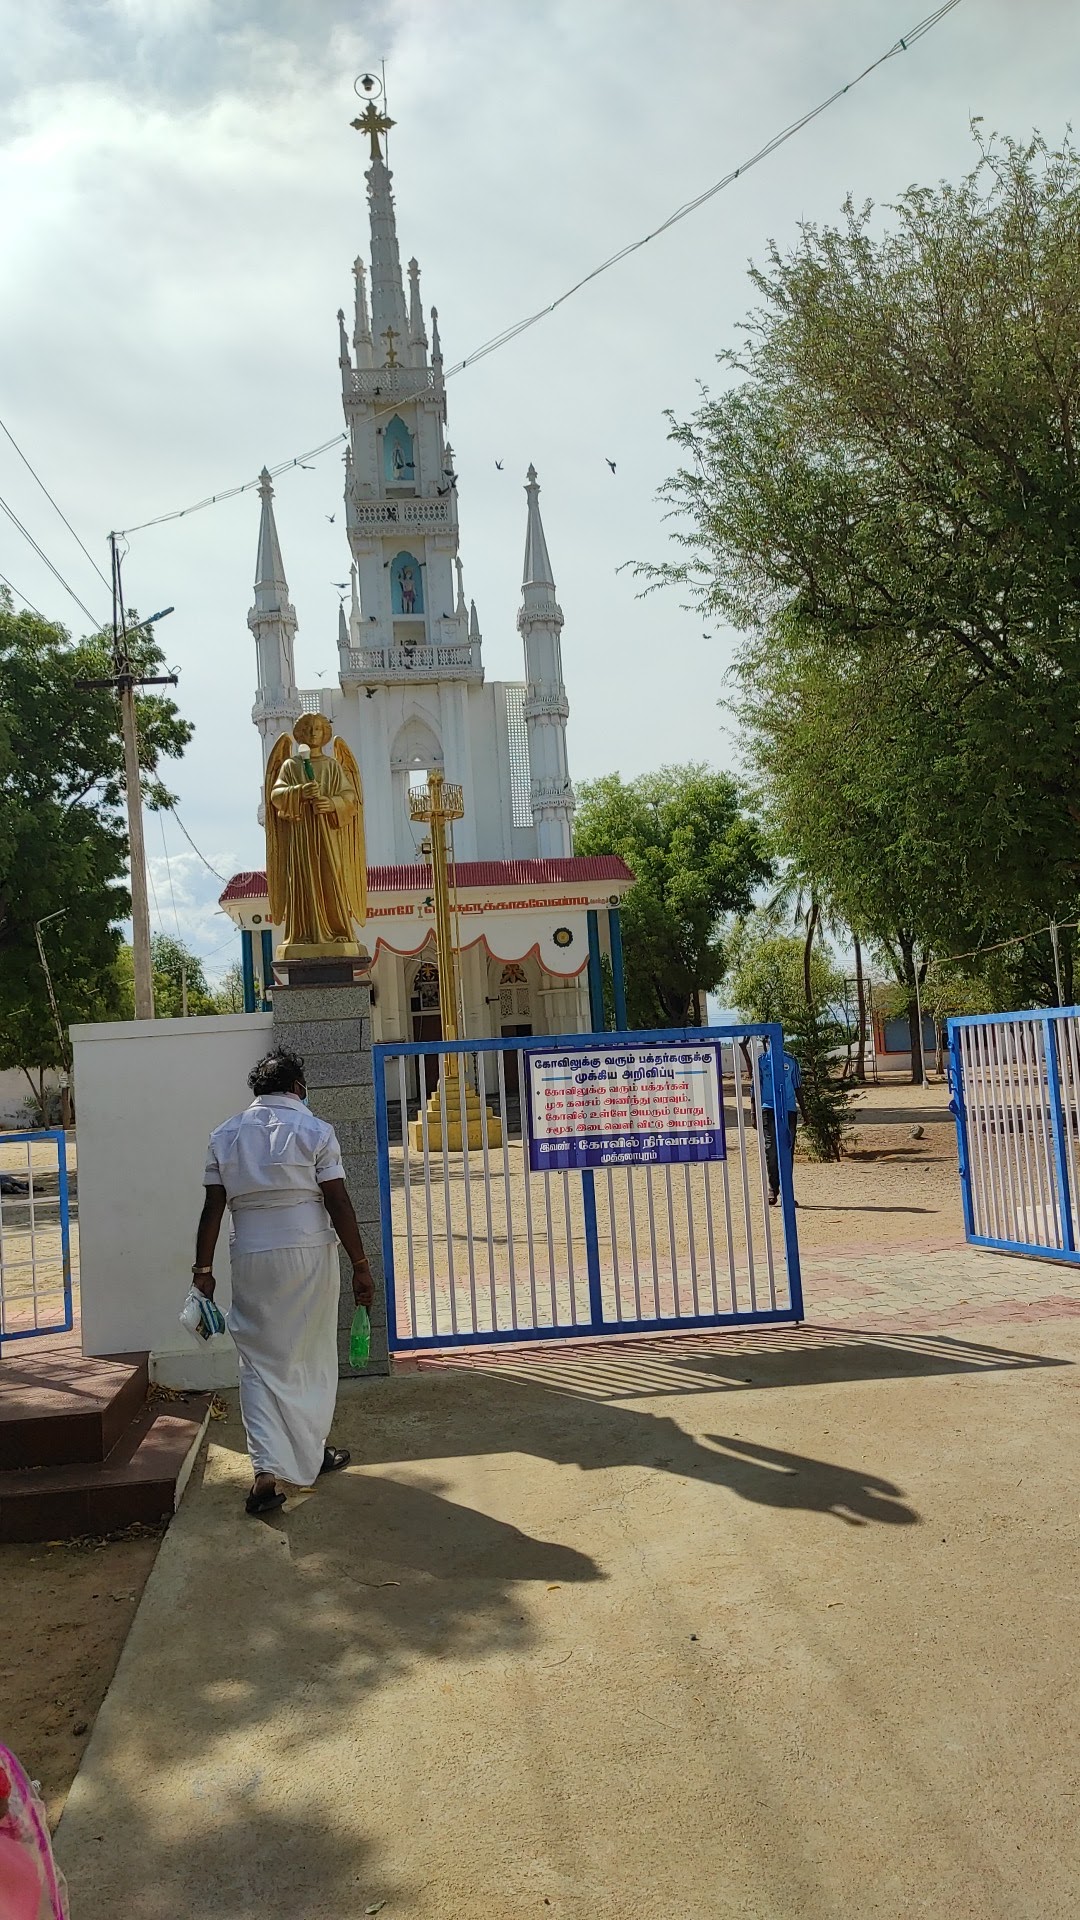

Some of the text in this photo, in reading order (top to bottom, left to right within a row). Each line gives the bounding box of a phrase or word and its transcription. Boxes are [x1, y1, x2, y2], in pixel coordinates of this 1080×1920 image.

[534, 1051, 713, 1071] கோவிலுக்கு வரும் பக்தர்களுக்கு
[575, 1066, 675, 1084] முக்கிய அறிவிப்பு
[544, 1080, 689, 1097] கோவிலுக்கு வரும் பக்தர்கள்
[544, 1093, 691, 1110] முக கவசம் அணிந்து வரவும்.
[545, 1105, 704, 1122] கோவில் உள்ளே அமரும் போது
[545, 1117, 716, 1136] சமூக இடைவெளி விட்டு அமரவும்.
[539, 1141, 571, 1153] இவண்
[578, 1136, 640, 1150] கோவில்
[642, 1133, 714, 1149] நிர்வாகம்
